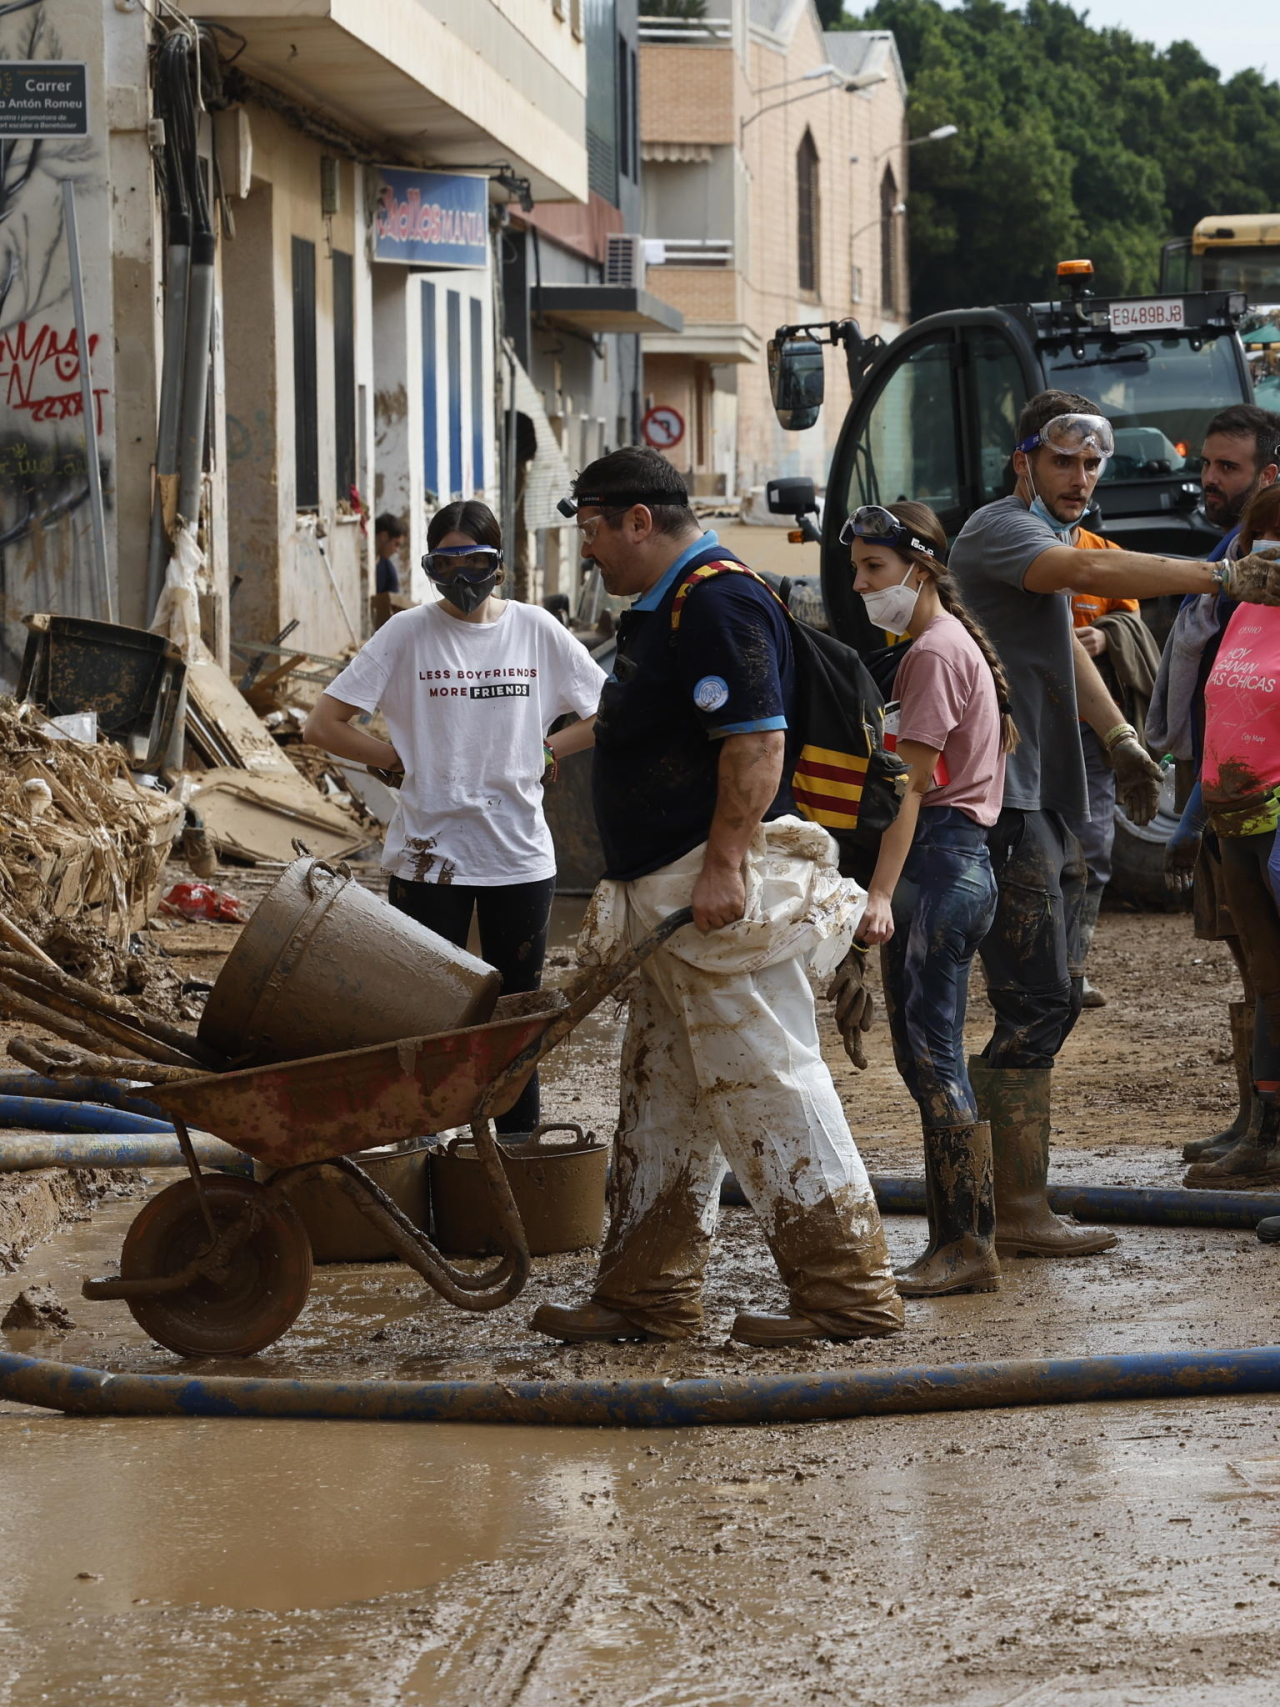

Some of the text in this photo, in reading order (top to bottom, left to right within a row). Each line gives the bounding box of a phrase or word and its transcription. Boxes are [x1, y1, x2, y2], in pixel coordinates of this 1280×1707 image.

[25, 79, 72, 92] Carrer
[8, 98, 42, 109] Antón
[44, 98, 83, 109] Romeu
[1225, 647, 1253, 660] HOY
[1215, 659, 1259, 674] GANAN
[419, 668, 537, 681] LESS BOYFRIENDS
[1226, 674, 1276, 693] CHICAS
[430, 685, 527, 698] MORE FRIENDS
